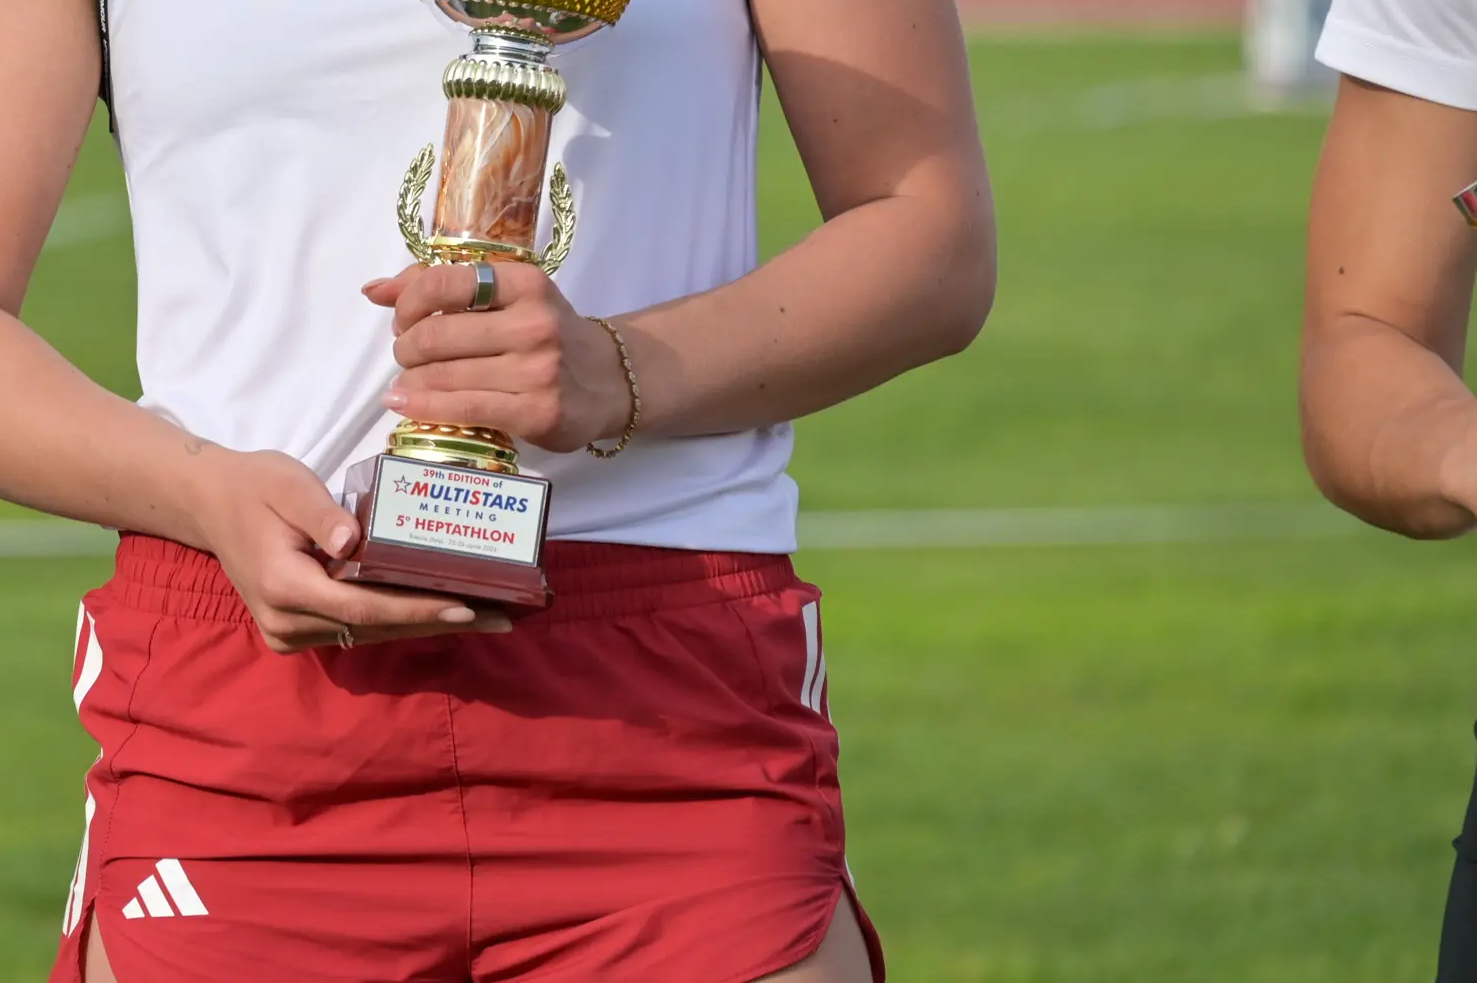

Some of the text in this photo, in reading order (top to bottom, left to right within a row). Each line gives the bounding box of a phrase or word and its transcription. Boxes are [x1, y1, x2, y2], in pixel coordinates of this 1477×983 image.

[423, 468, 503, 489] 39th EDITION of
[410, 481, 529, 513] MULTISTARS
[419, 502, 497, 522] MEETING
[415, 517, 515, 545] HEPTATHLON
